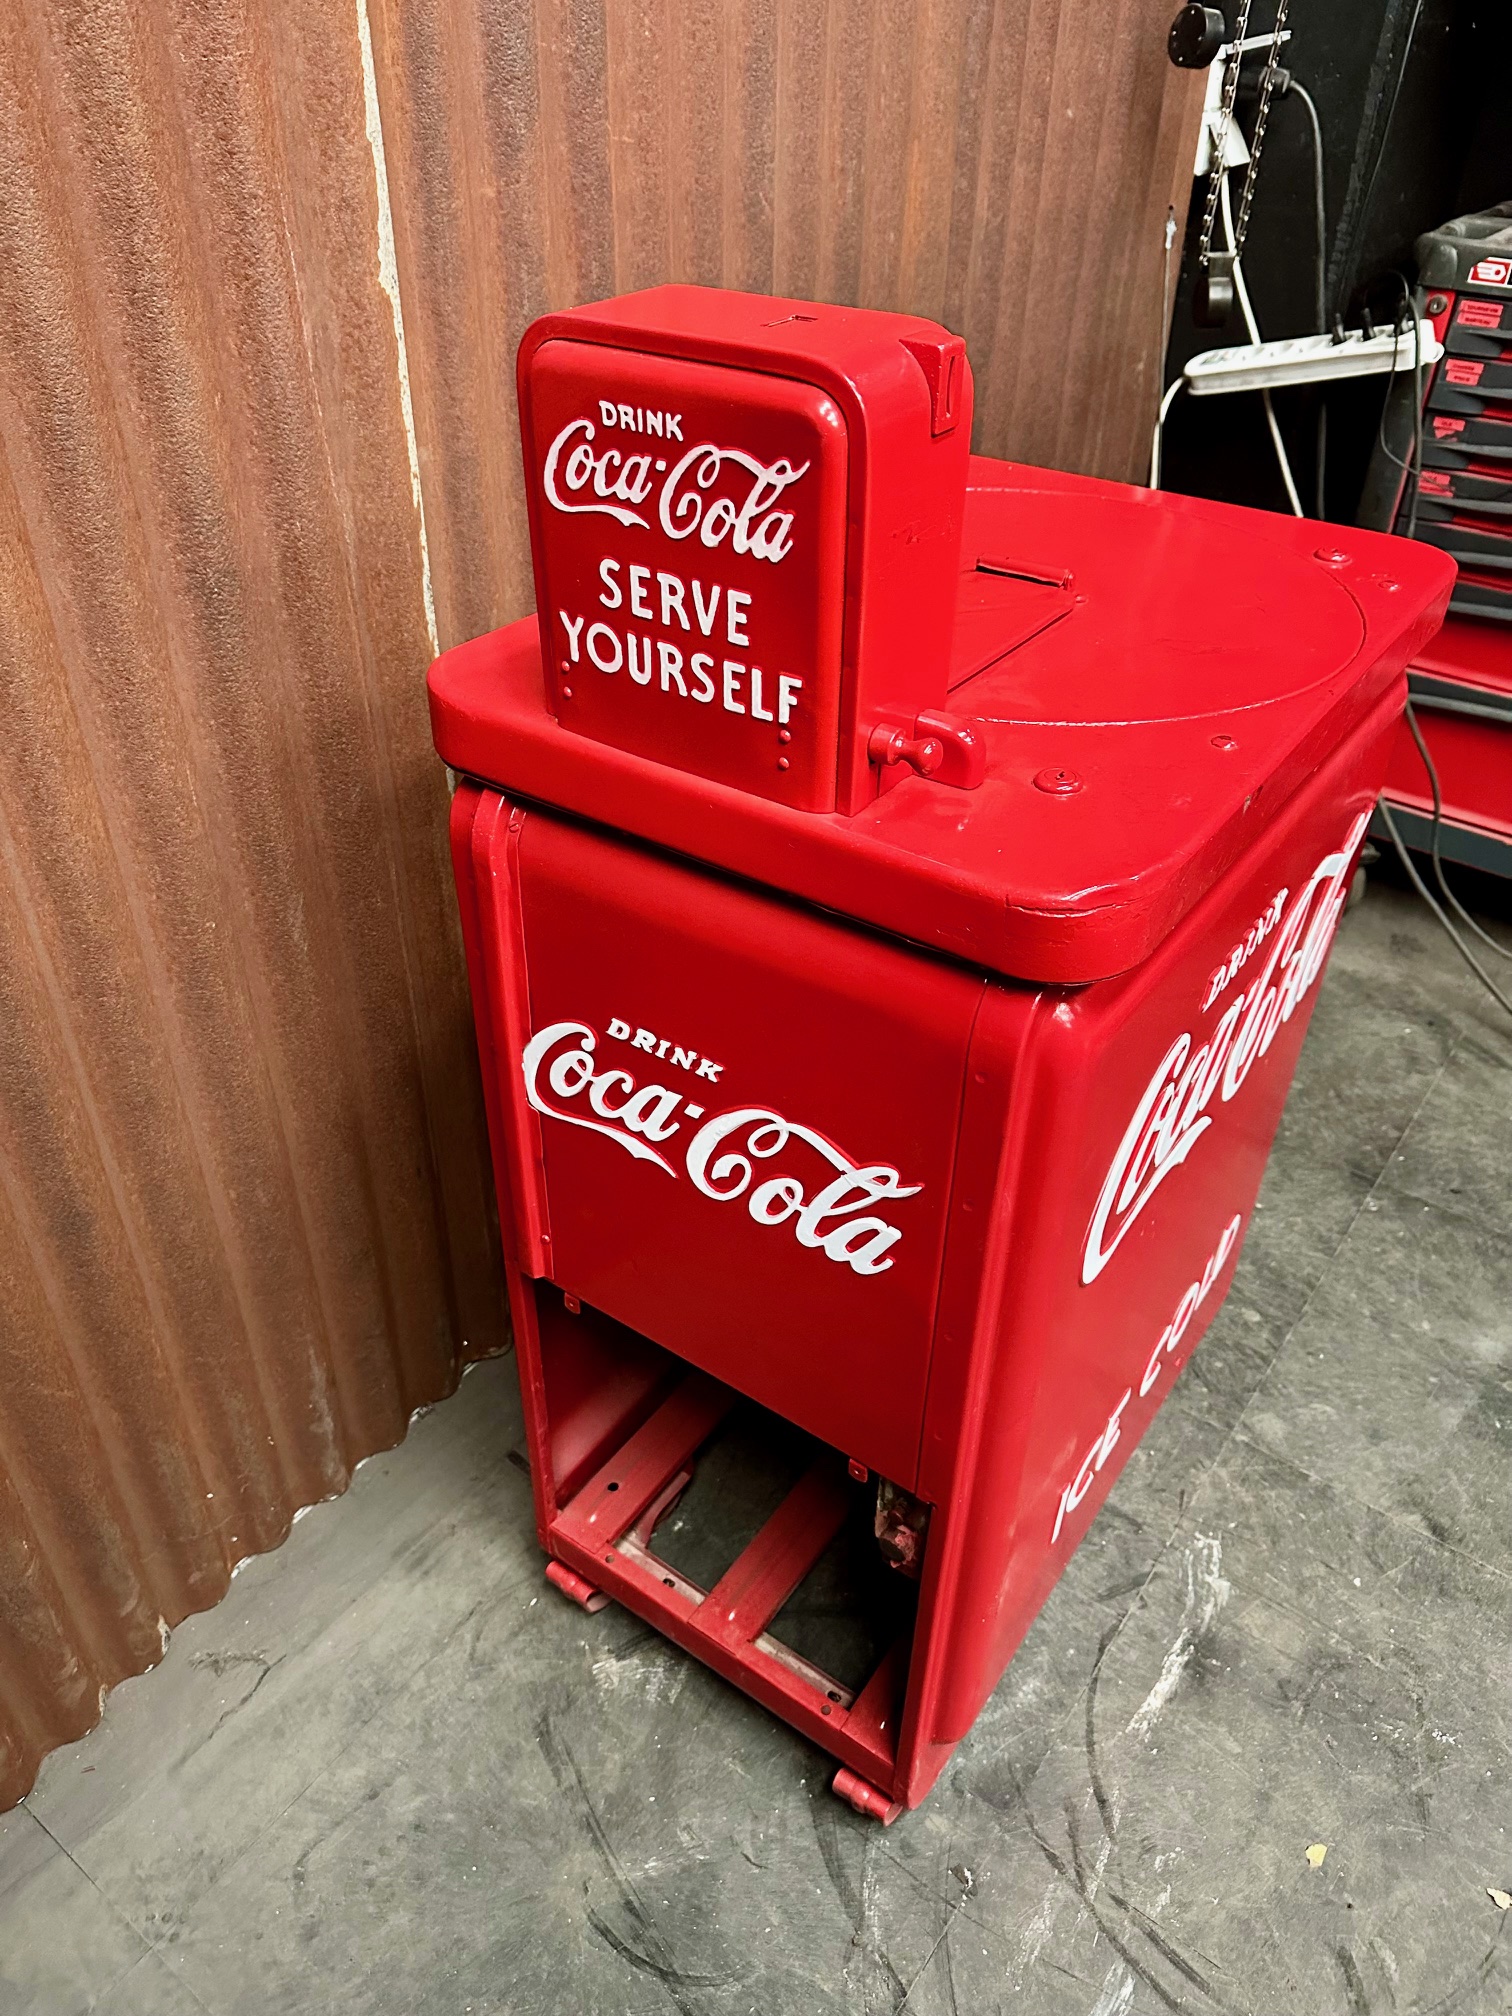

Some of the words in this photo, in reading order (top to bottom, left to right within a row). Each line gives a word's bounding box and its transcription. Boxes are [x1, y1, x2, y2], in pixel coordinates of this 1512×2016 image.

[599, 400, 684, 442] DRINK
[543, 420, 811, 563] Coca-Cola
[599, 558, 752, 647] SERVE
[559, 610, 803, 724] YOURSELF
[1201, 887, 1289, 1014] DRINK
[605, 1017, 724, 1083] DRINK
[521, 1022, 923, 1275] Coca-Cola
[1051, 1386, 1132, 1544] ICE
[1138, 1214, 1241, 1397] COLD
